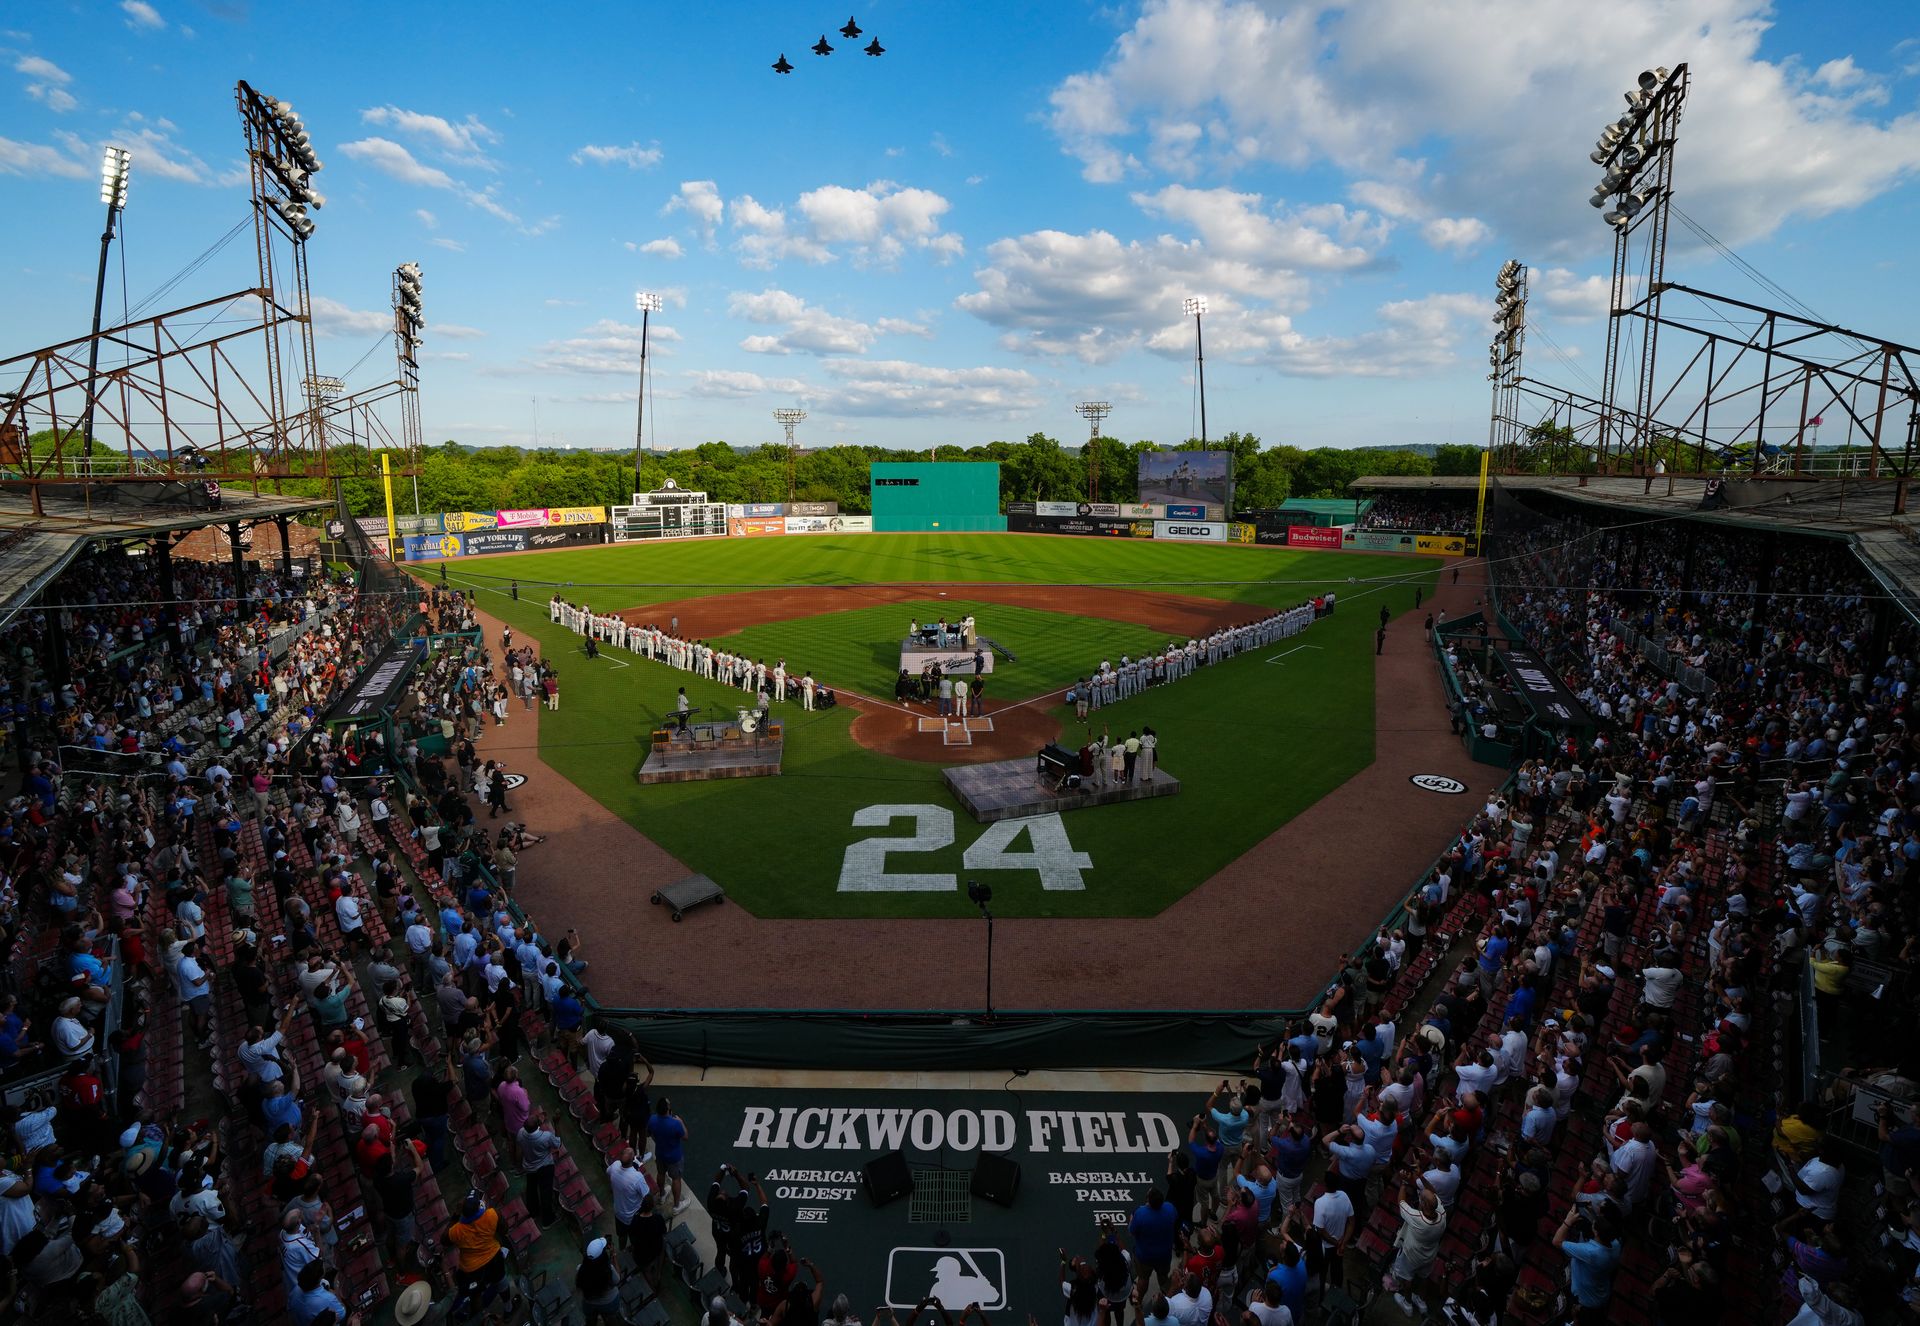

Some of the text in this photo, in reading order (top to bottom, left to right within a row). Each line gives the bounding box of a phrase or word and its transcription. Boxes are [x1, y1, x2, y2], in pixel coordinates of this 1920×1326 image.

[1168, 526, 1211, 536] GEICO
[468, 535, 486, 545] NEW
[486, 534, 507, 542] YORK
[507, 534, 523, 542] LIFE
[1292, 533, 1337, 543] Budweiser
[837, 803, 1094, 892] 24
[733, 1106, 1180, 1153] RICKWOOD FIELD
[1048, 1172, 1154, 1184] BASEBALL
[775, 1186, 1134, 1202] OLDEST PARK
[796, 1210, 828, 1221] EST.
